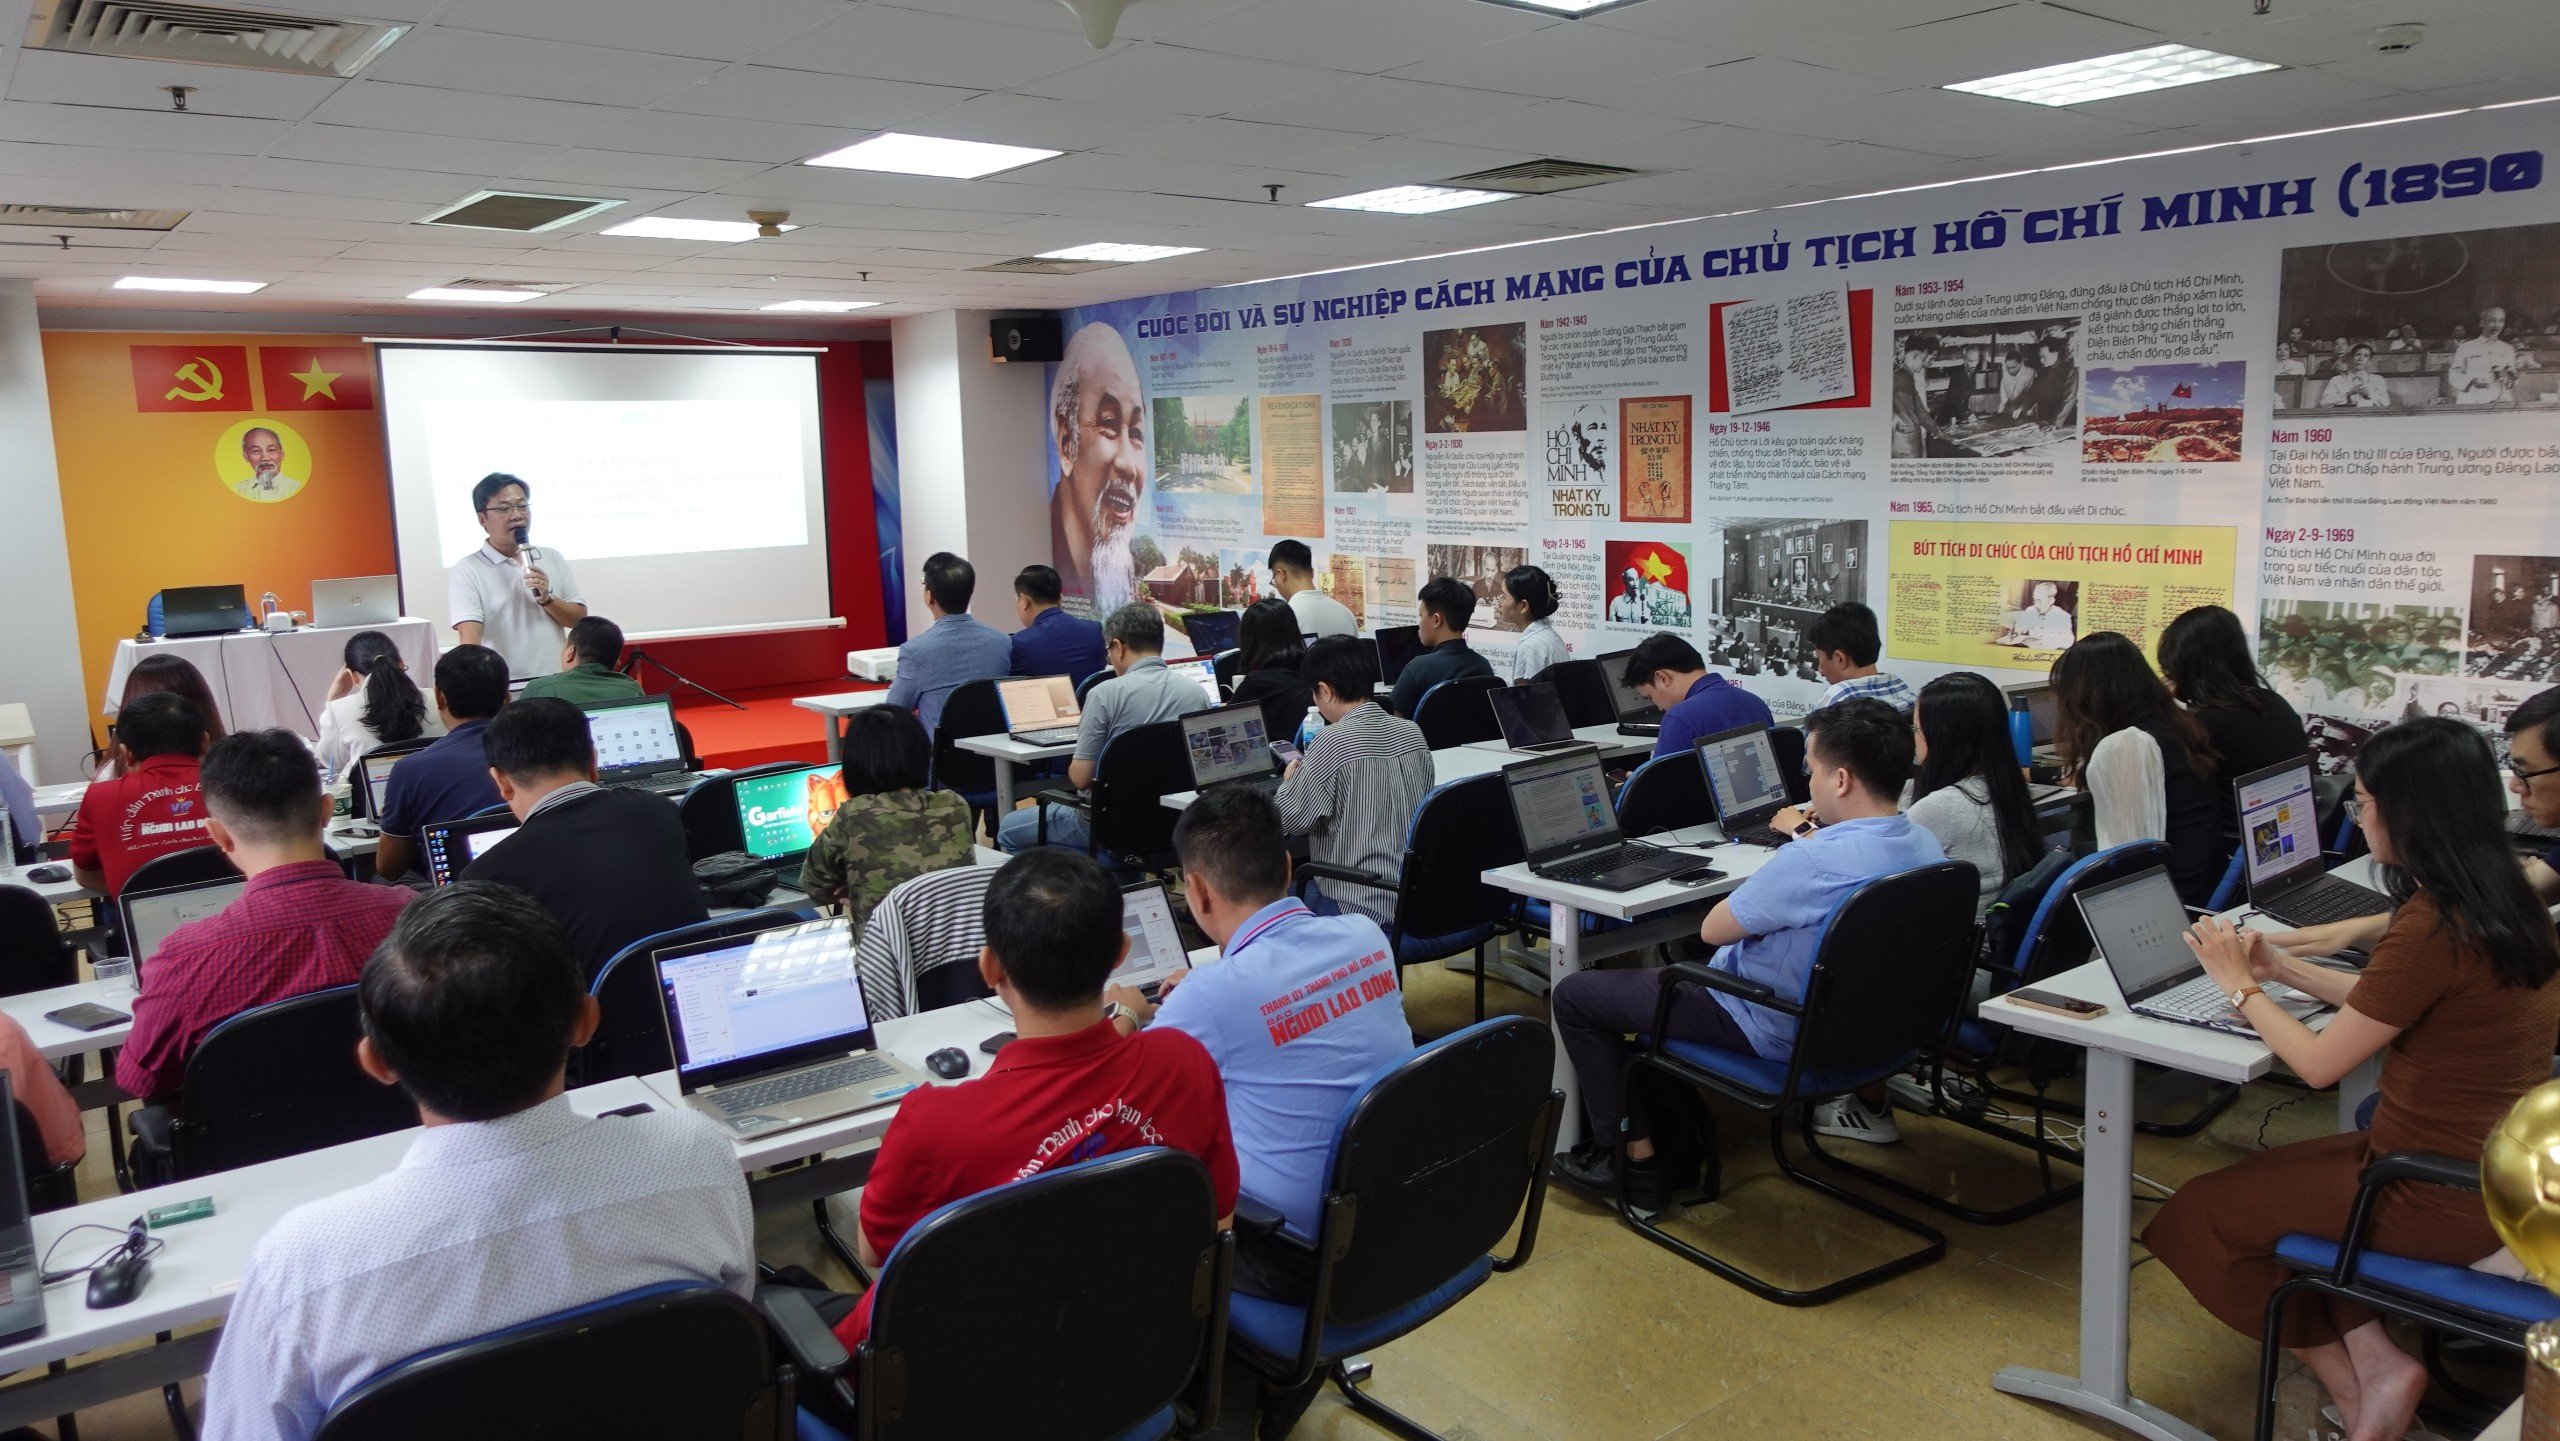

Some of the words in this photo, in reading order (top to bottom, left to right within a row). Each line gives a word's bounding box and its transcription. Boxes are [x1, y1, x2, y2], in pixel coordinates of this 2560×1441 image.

[1137, 313, 1188, 338] CUỘC
[1194, 308, 1231, 334] ĐỜI
[1240, 303, 1268, 329] VÀ
[1274, 299, 1306, 325] SỰ
[1313, 288, 1408, 322] NGHIỆP
[1414, 272, 1495, 311] CÁCH
[1505, 265, 1604, 301] MẠNG
[1615, 246, 1691, 285] CỦA
[1703, 229, 1791, 277] CHỦ
[1805, 226, 1917, 270] TỊCH
[1932, 209, 2023, 254] HỒ
[2023, 192, 2124, 244] CHÍ
[2140, 177, 2318, 232] MINH
[2338, 149, 2544, 218] (1890
[1895, 285, 1915, 296] Năm
[1918, 279, 1964, 294] 1953-1954
[2088, 311, 2101, 325] đã
[2103, 309, 2132, 323] giành
[2134, 308, 2160, 318] được
[2162, 304, 2194, 319] thắng
[2196, 303, 2210, 317] lợi
[2212, 303, 2224, 313] to
[2225, 300, 2246, 312] lớn,
[2088, 321, 2106, 335] kết
[2106, 321, 2130, 334] thúc
[2132, 319, 2158, 334] bằng
[2160, 318, 2190, 330] chiến
[2193, 317, 2225, 328] thắng
[2087, 337, 2110, 349] Điện
[2112, 335, 2135, 346] Biên
[2137, 333, 2158, 344] Phủ
[2160, 333, 2188, 345] “lừng
[2191, 330, 2207, 344] lẫy
[2209, 329, 2234, 340] năm
[2087, 348, 2114, 362] châu,
[2117, 347, 2142, 360] chấn
[2144, 347, 2172, 359] động
[2174, 346, 2191, 358] địa
[2193, 343, 2220, 356] cầu”.
[1730, 421, 1770, 433] 19-12-1946
[2272, 430, 2299, 443] Năm
[2304, 428, 2332, 442] 1960
[1629, 433, 1665, 445] TRONG
[2270, 449, 2287, 460] Tại
[2289, 449, 2308, 461] Đại
[2311, 449, 2329, 460] hội
[2332, 447, 2350, 460] lần
[2353, 448, 2375, 460] thứ
[2377, 448, 2387, 459] III
[2390, 447, 2414, 460] của
[2416, 447, 2454, 461] Đảng,
[2458, 447, 2497, 461] Người
[2500, 447, 2535, 460] được
[1547, 464, 1587, 481] MINH
[2269, 463, 2292, 474] Chủ
[2295, 462, 2317, 476] tịch
[2320, 463, 2344, 474] Ban
[2346, 461, 2379, 476] Chấp
[2381, 463, 2414, 474] hành
[2417, 462, 2454, 476] Trung
[2458, 464, 2492, 476] ương
[2494, 461, 2531, 476] Đảng
[2534, 462, 2560, 473] Lao
[2268, 477, 2291, 490] Việt
[2293, 478, 2324, 488] Nam.
[1553, 503, 1593, 516] TRONG
[1890, 501, 1910, 512] Năm
[1913, 501, 1935, 514] 1965,
[1937, 503, 1954, 514] Chủ
[1955, 504, 1972, 515] tịch
[1974, 503, 1987, 514] Hồ
[1989, 504, 2004, 514] Chí
[2005, 505, 2028, 514] Minh
[2029, 503, 2045, 514] bắt
[2047, 504, 2065, 515] đầu
[2067, 504, 2086, 515] viết
[2087, 505, 2097, 516] Di
[2099, 506, 2126, 516] chúc.
[1558, 538, 1586, 549] 2-9-1945
[2266, 527, 2296, 543] Ngày
[2298, 528, 2354, 542] 2-9-1969
[1914, 539, 1936, 556] BÚT
[1939, 540, 1966, 557] TÍCH
[1969, 543, 1983, 558] DI
[1986, 541, 2017, 559] CHÚC
[2021, 542, 2045, 560] CỦA
[2049, 543, 2074, 560] CHỦ
[2078, 546, 2108, 564] TỊCH
[2112, 544, 2132, 562] HỒ
[2136, 545, 2159, 564] CHÍ
[2163, 549, 2202, 565] MINH
[2264, 546, 2287, 558] Chủ
[2289, 548, 2312, 560] tịch
[2315, 547, 2332, 559] Hồ
[2334, 548, 2355, 560] Chí
[2356, 549, 2386, 560] Minh
[2389, 552, 2413, 563] qua
[2415, 551, 2436, 562] đời
[2263, 561, 2295, 575] trong
[2297, 563, 2313, 574] sự
[2314, 561, 2336, 574] tiếc
[2339, 562, 2366, 574] nuối
[2368, 563, 2391, 576] của
[2394, 565, 2418, 576] dân
[2421, 565, 2442, 578] tộc
[2263, 574, 2285, 586] Việt
[2287, 575, 2315, 586] Nam
[2317, 576, 2332, 587] và
[2334, 577, 2365, 588] nhân
[2368, 578, 2391, 589] dân
[2394, 578, 2417, 590] thế
[2418, 577, 2444, 593] giới.
[169, 800, 194, 813] VIP
[1326, 986, 1362, 1019] LAO
[1359, 969, 1397, 1003] ĐỘNG
[1084, 1103, 1114, 1127] cho
